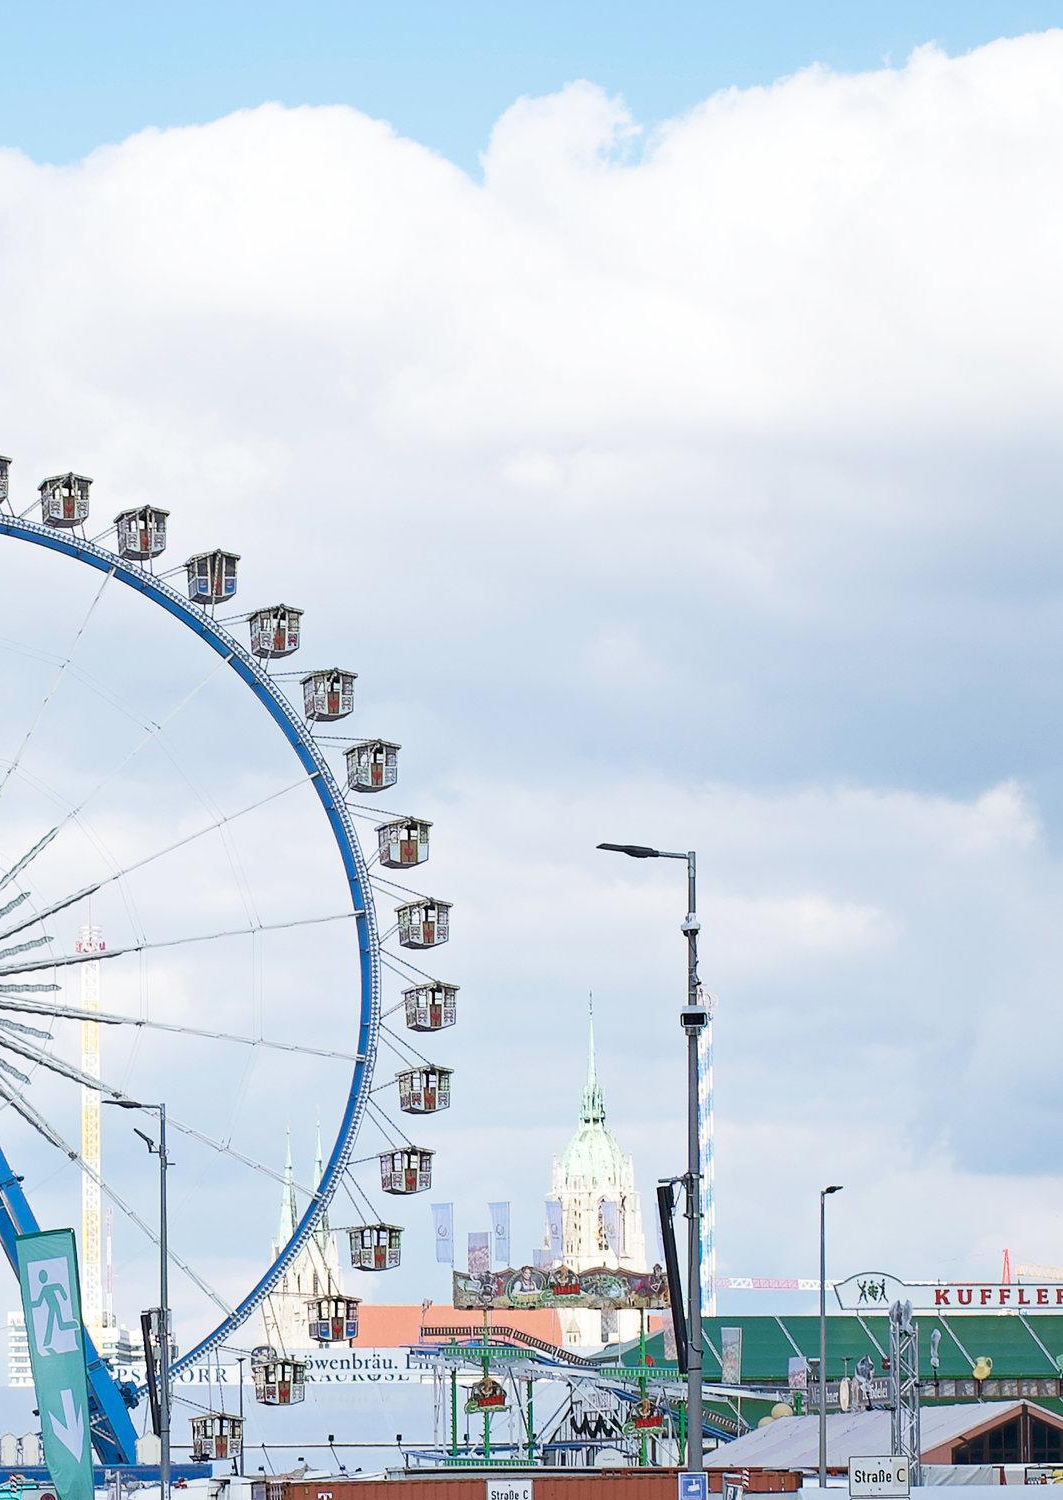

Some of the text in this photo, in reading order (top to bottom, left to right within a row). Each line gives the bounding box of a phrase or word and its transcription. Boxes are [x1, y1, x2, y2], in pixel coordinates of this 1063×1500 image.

[854, 1469, 905, 1483] Straße C
[491, 1490, 528, 1500] Straße C
